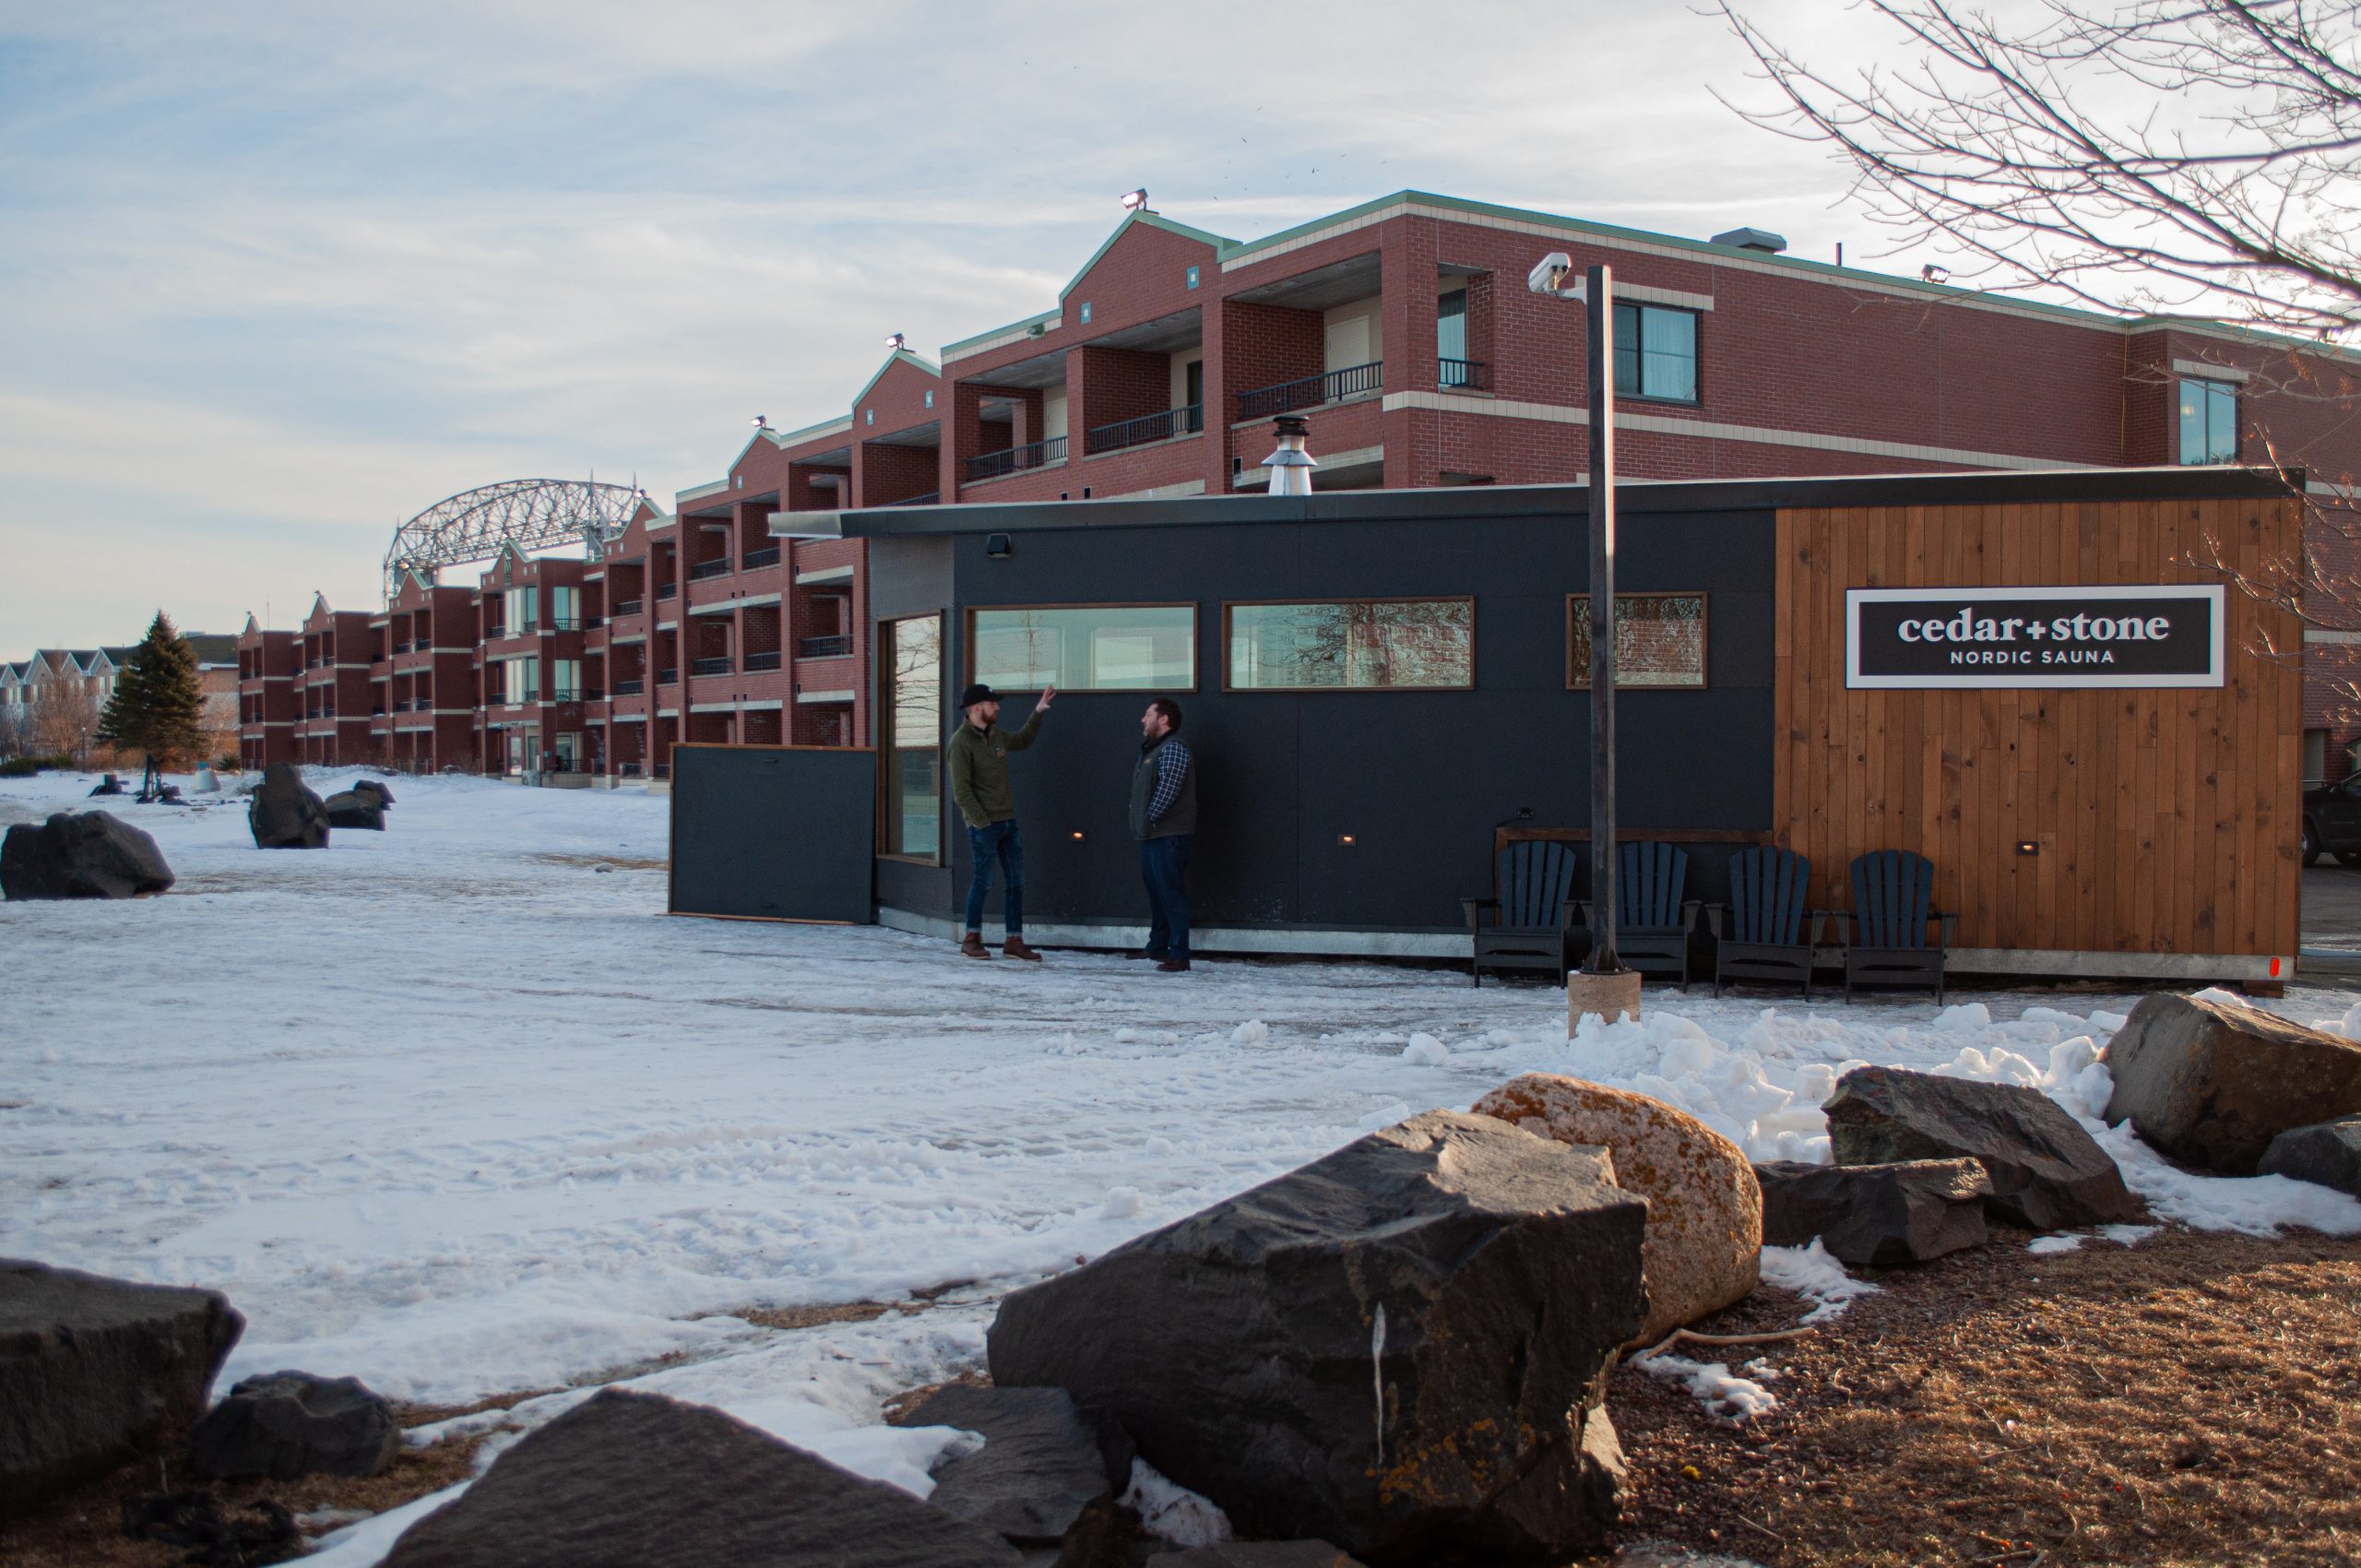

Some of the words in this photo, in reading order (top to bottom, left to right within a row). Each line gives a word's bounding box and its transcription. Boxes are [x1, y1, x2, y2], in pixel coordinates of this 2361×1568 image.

[1898, 607, 2169, 642] cedar+stone
[1951, 650, 2032, 664] NORDIC
[2041, 649, 2115, 663] SAUNA
